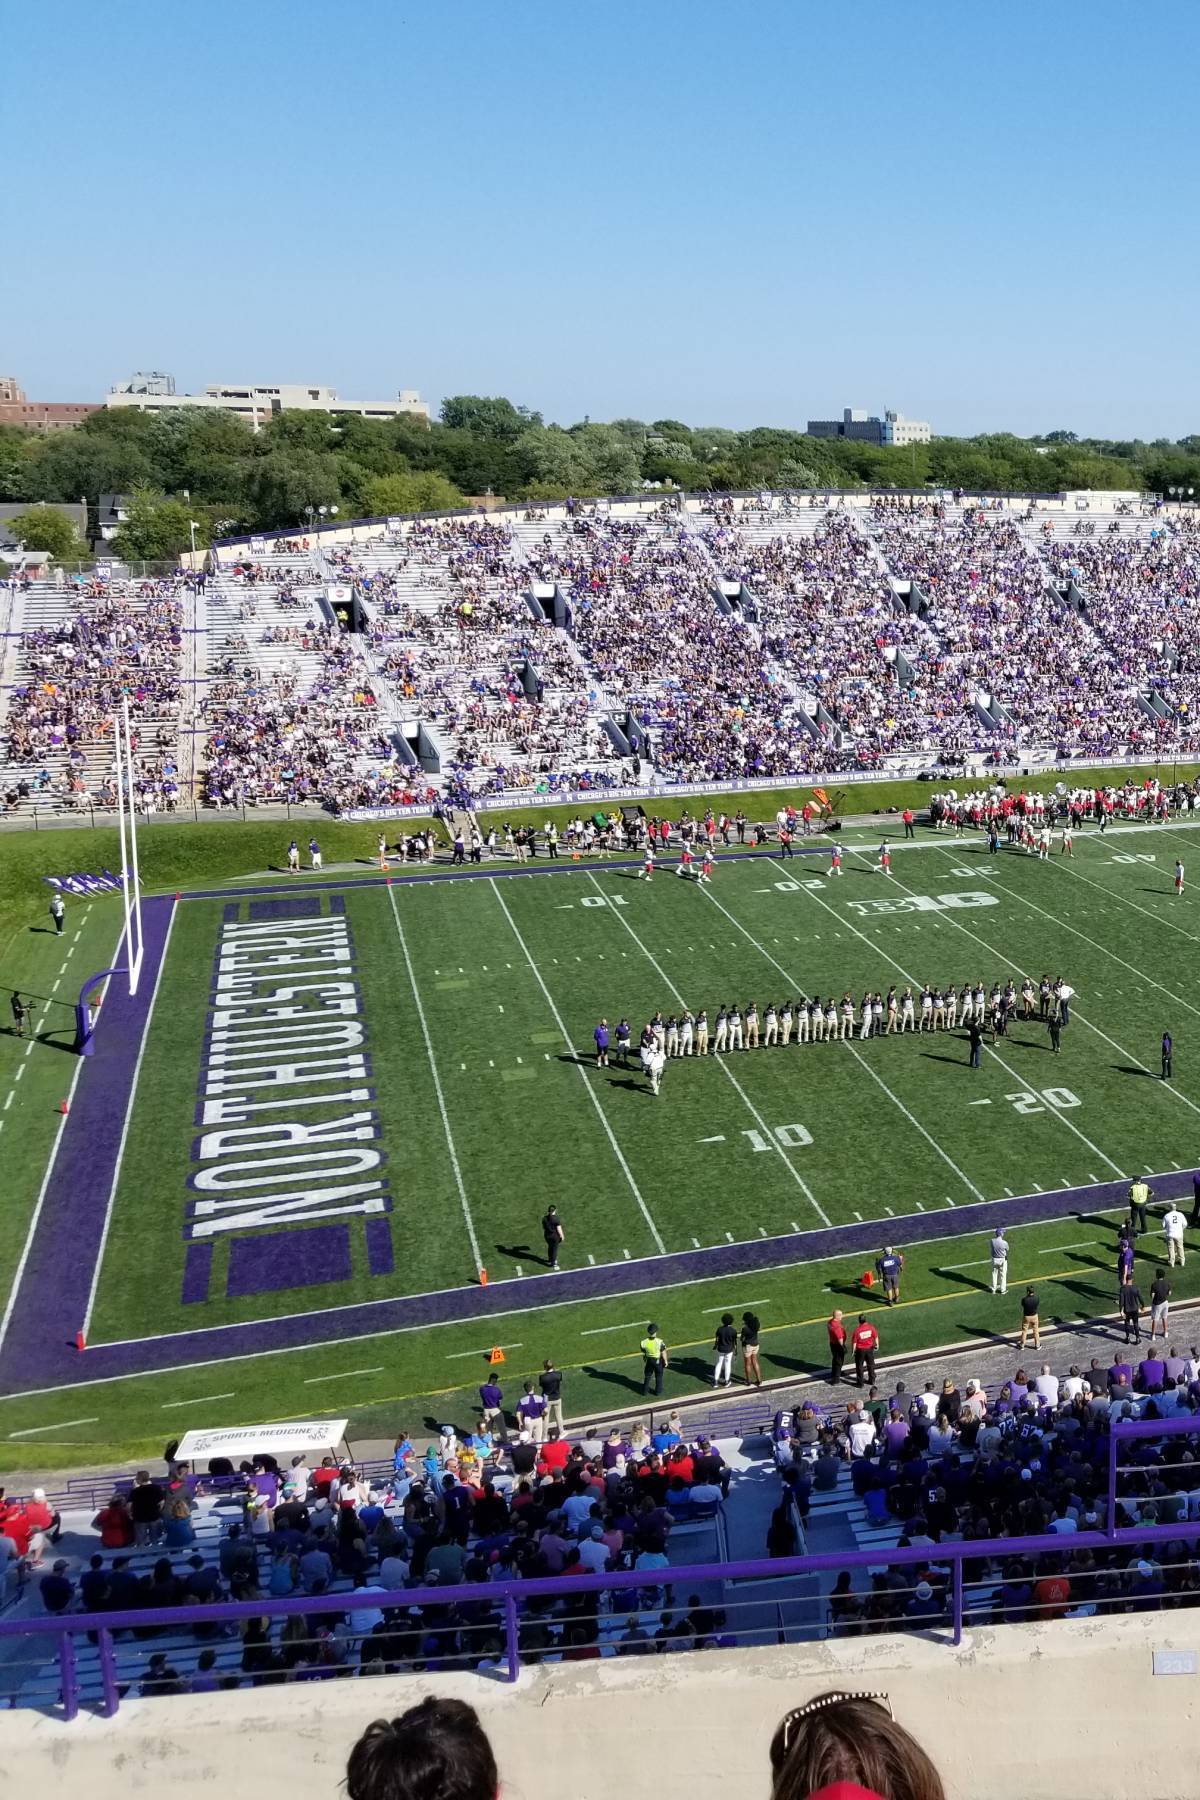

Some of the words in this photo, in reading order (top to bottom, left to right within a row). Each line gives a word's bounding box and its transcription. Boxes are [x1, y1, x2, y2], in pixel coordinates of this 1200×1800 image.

[1110, 853, 1157, 864] 40
[951, 865, 1001, 877] 30
[773, 879, 827, 892] 20
[580, 894, 629, 908] 10
[192, 916, 384, 1237] NORTHWESTERN
[1003, 1087, 1082, 1114] 20
[741, 1123, 814, 1152] 10
[1172, 1216, 1178, 1224] 2
[493, 1350, 501, 1360] G
[781, 1416, 790, 1427] 2
[212, 1431, 256, 1442] SPORTS
[260, 1427, 312, 1437] MEDICINE
[454, 1496, 461, 1509] 1
[1161, 1659, 1193, 1673] 233
